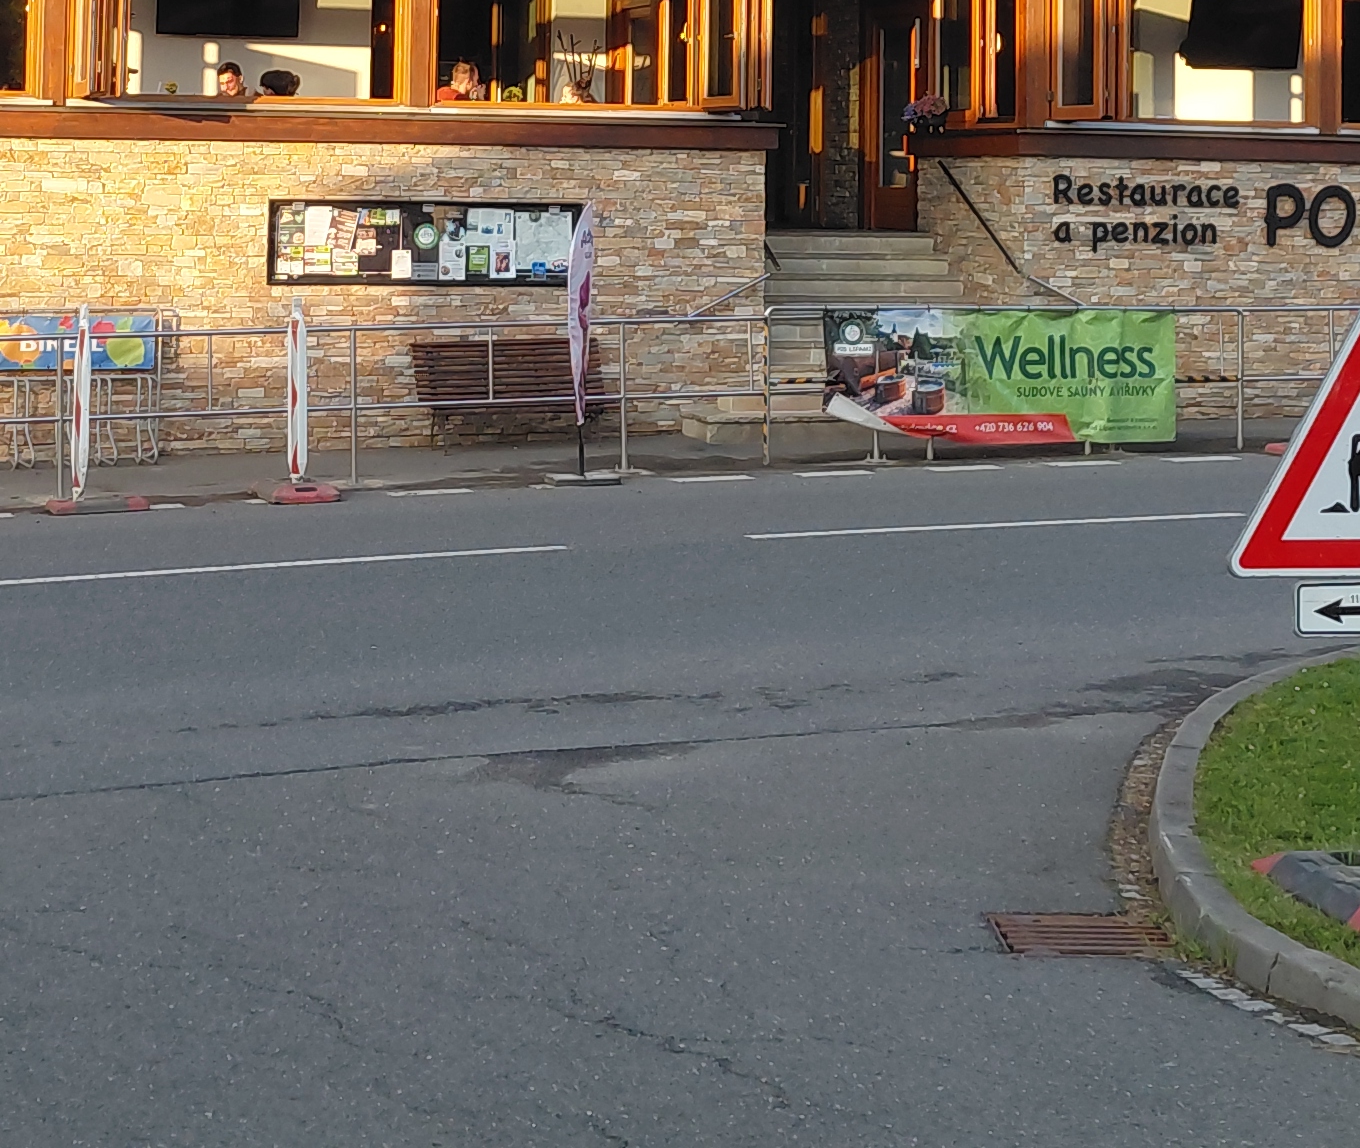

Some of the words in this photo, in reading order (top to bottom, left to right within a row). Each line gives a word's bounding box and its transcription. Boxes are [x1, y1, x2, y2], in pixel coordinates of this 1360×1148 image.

[1051, 173, 1241, 210] Restaurace
[1052, 221, 1073, 244] a
[1088, 213, 1219, 254] penzion
[973, 333, 1157, 381] Wellness
[1067, 385, 1107, 398] SAUNY
[974, 422, 997, 433] +420
[997, 421, 1015, 432] 736
[1016, 421, 1035, 432] 626
